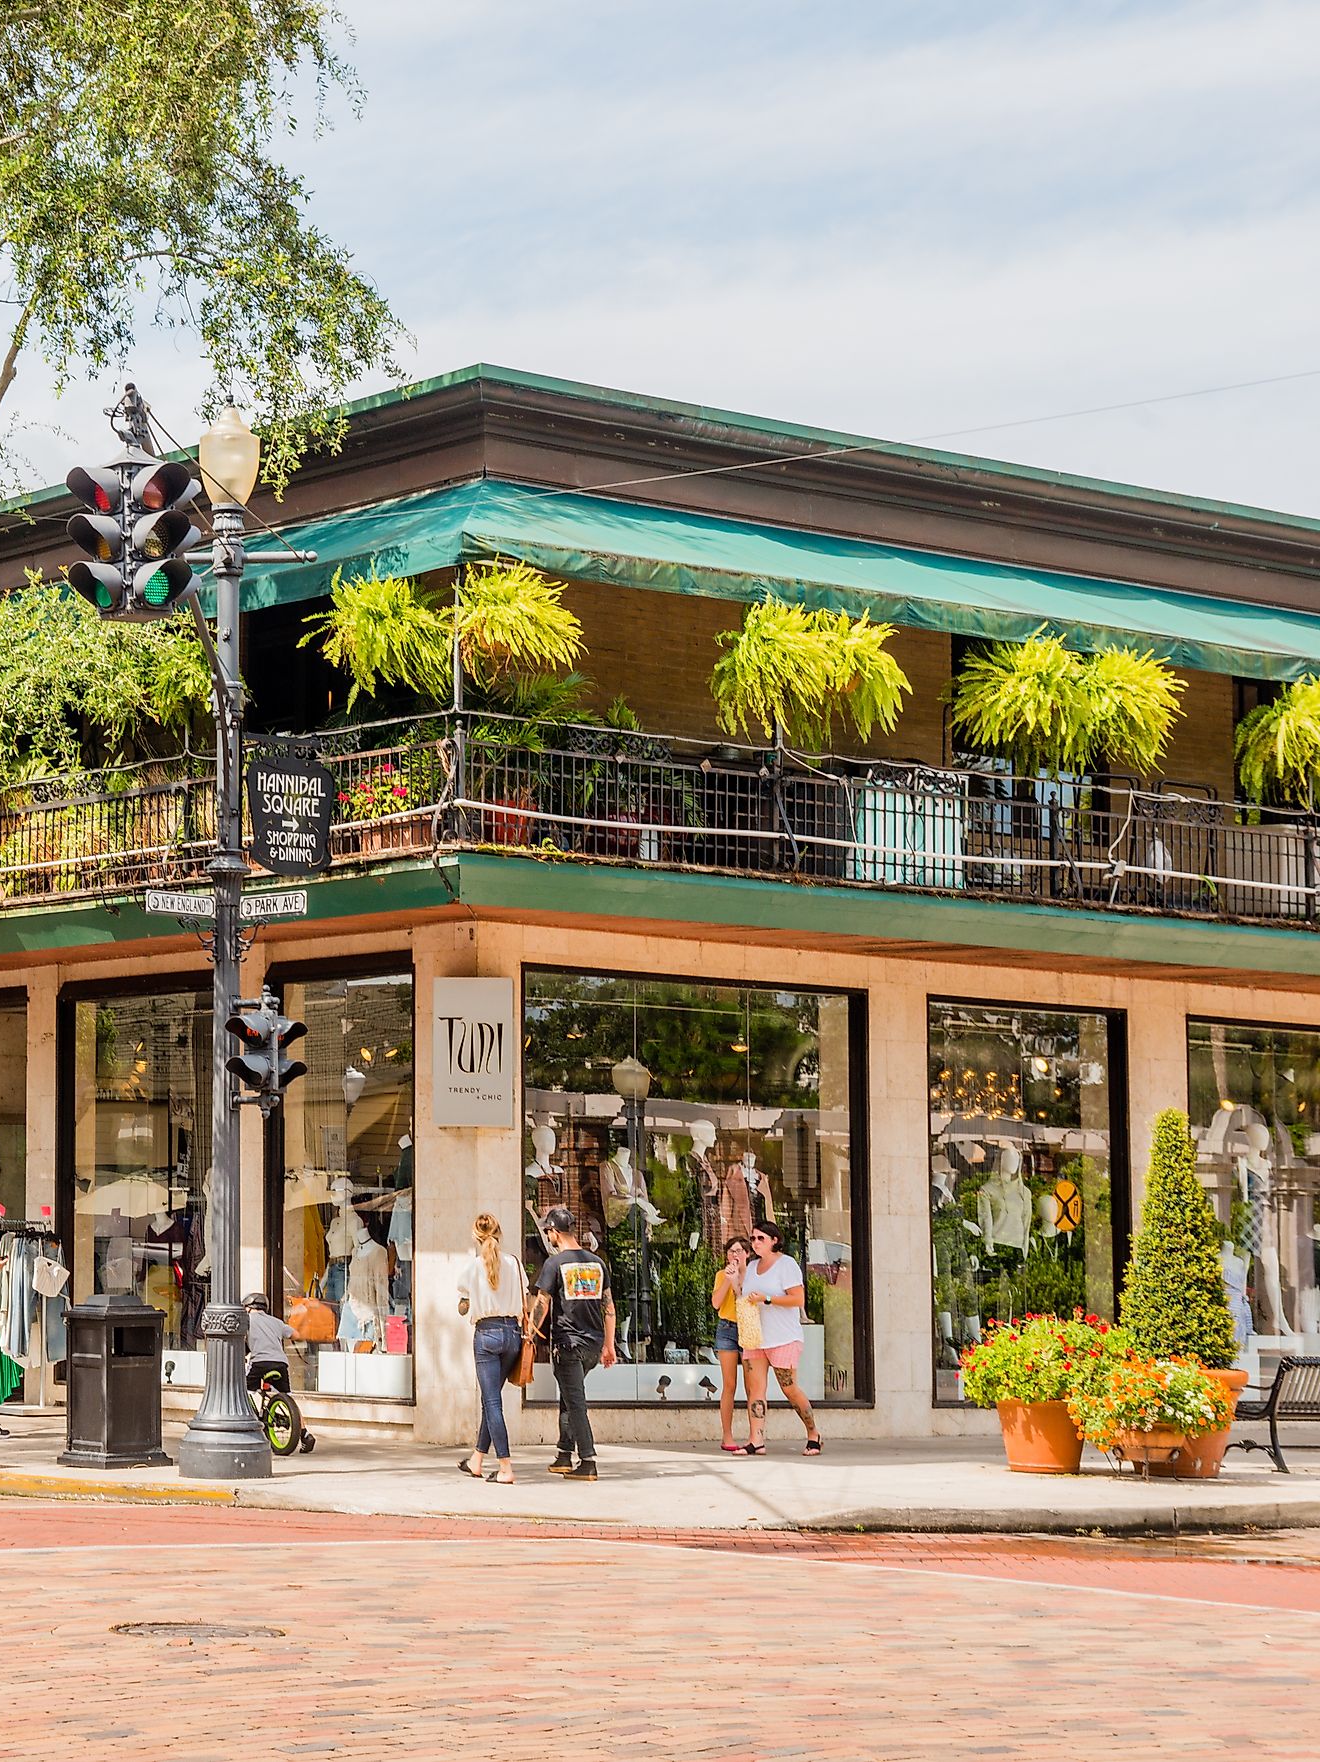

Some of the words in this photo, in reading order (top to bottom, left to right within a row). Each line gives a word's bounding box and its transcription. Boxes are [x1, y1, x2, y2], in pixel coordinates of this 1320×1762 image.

[257, 772, 326, 797] HANNIBAL
[262, 794, 320, 817] SQUARE
[266, 831, 316, 848] SHOPPING
[161, 896, 175, 910] NEW
[177, 897, 207, 914] ENGLAND
[255, 898, 279, 915] PARK
[283, 896, 300, 911] AVE
